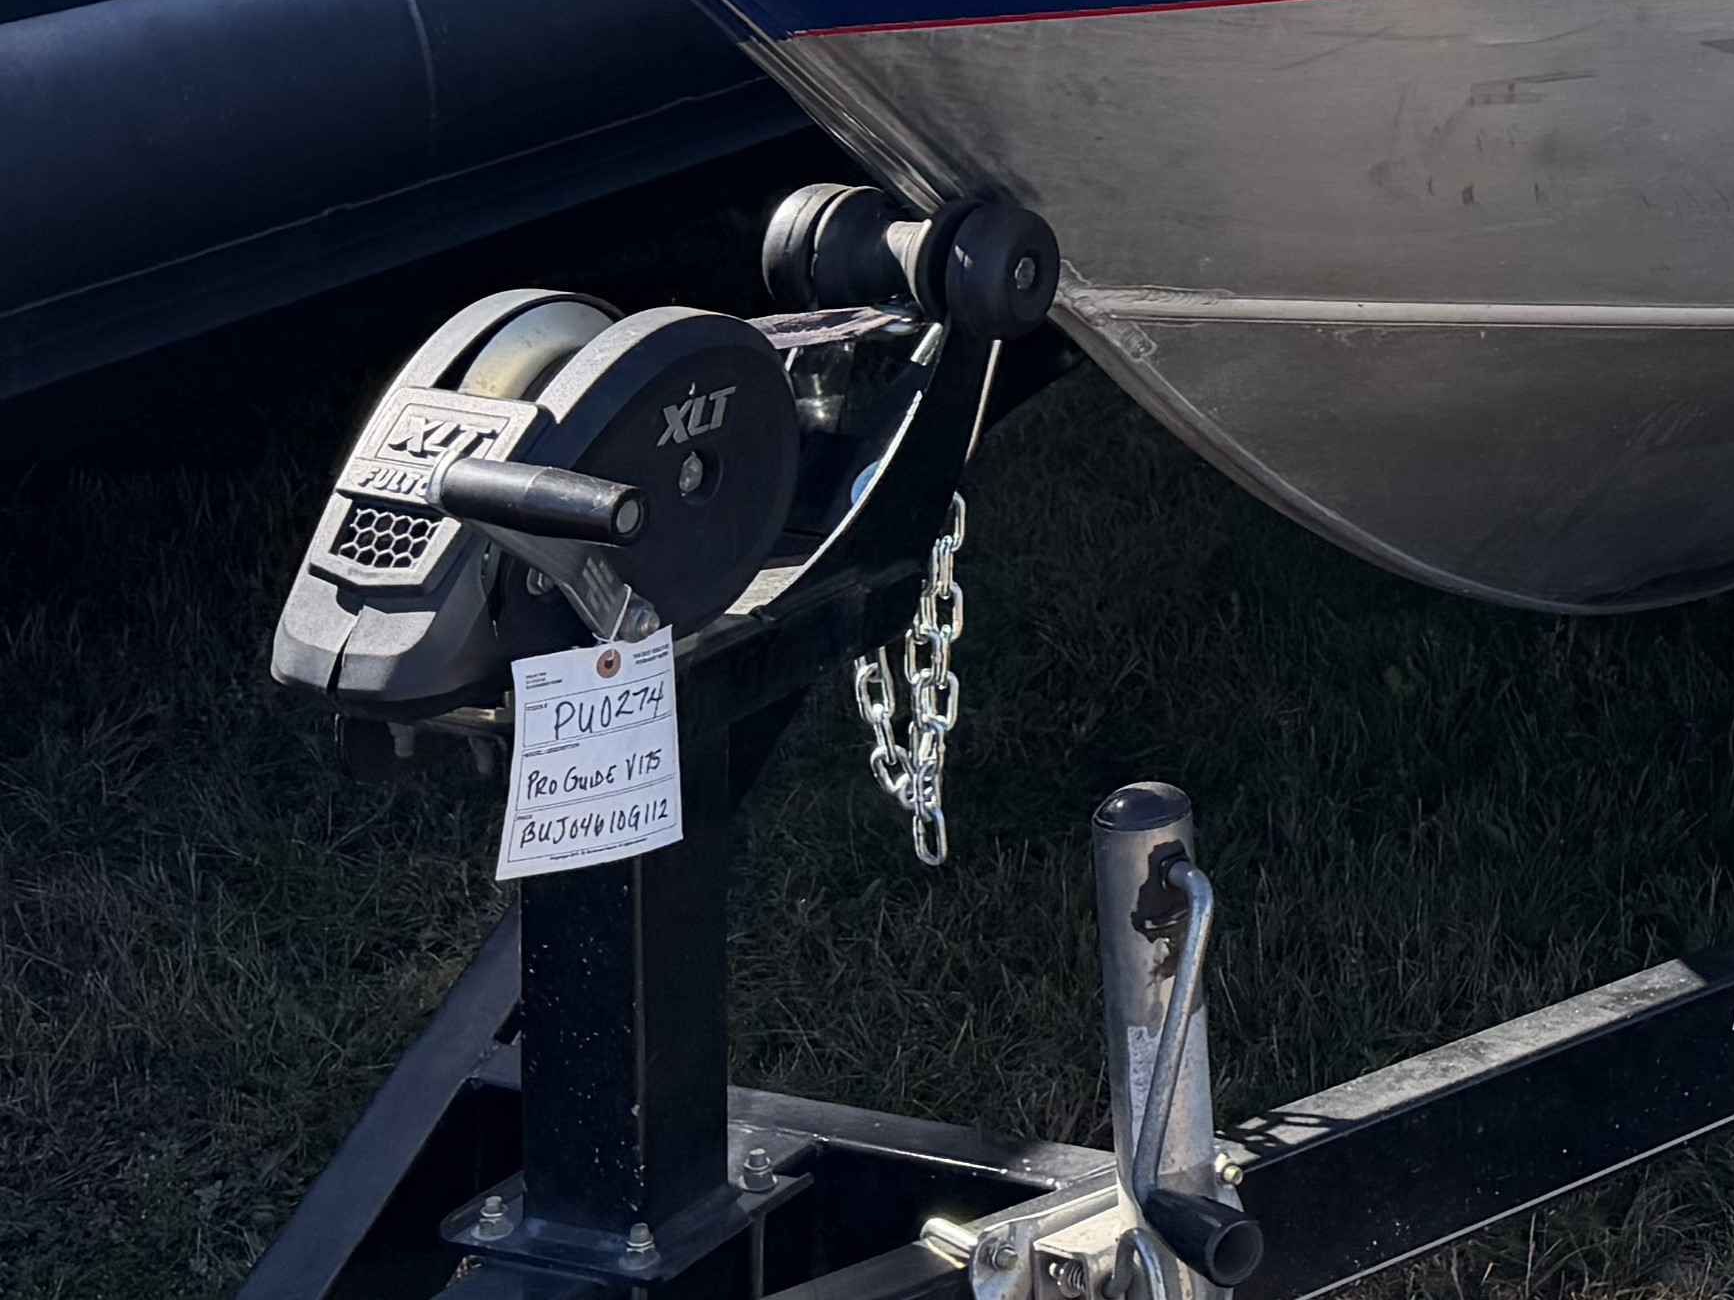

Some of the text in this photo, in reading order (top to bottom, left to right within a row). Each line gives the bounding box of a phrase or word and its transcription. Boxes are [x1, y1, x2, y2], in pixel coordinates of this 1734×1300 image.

[388, 416, 498, 458] XLT
[656, 386, 736, 447] XLT
[554, 680, 664, 741] PU0274
